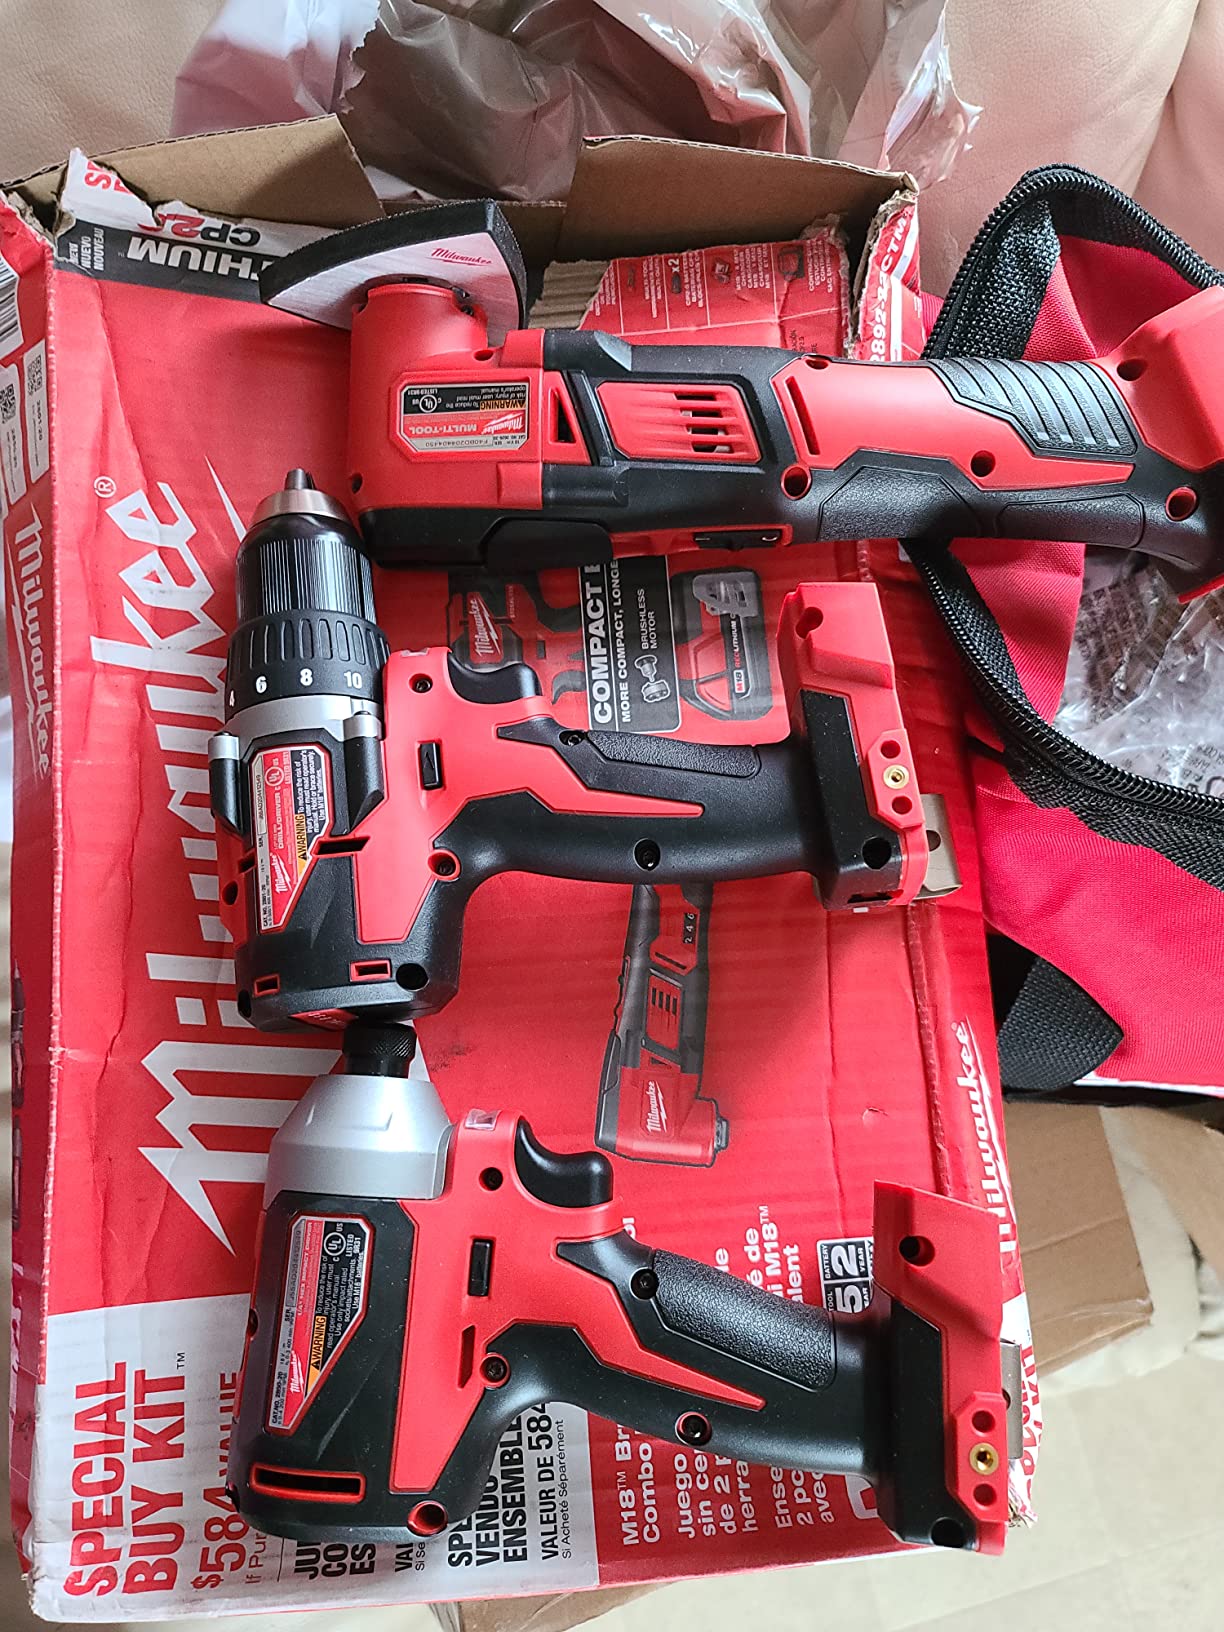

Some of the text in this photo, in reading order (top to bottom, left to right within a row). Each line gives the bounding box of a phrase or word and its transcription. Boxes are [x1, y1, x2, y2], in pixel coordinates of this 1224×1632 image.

[93, 228, 104, 271] NOUVEAU
[431, 248, 492, 264] Milwaukee
[668, 258, 679, 272] x2
[423, 397, 433, 408] UL
[479, 399, 518, 410] WARNING
[408, 423, 476, 434] MULTI-TOOL
[480, 416, 523, 434] Milwaukee
[467, 598, 494, 656] Milwaukee
[637, 588, 649, 649] BRUSHLESS
[647, 610, 657, 648] MOTOR
[15, 513, 50, 773] Milwaukee
[583, 580, 614, 724] COMPACT
[613, 608, 628, 678] COMPACT,
[255, 668, 363, 694] 6 8 10
[734, 670, 744, 692] M18
[619, 681, 631, 722] MORE
[268, 771, 279, 782] UL
[302, 777, 310, 789] read
[309, 775, 317, 789] brace
[303, 789, 311, 803] must
[304, 803, 312, 816] user
[274, 792, 284, 848] DRILL/DRIVER
[295, 814, 306, 853] WARNING
[305, 816, 313, 833] injury,
[270, 852, 288, 892] Milwaukee
[685, 924, 694, 932] 4
[686, 912, 694, 920] 6
[645, 1080, 661, 1132] Milwaukee
[336, 1222, 343, 1231] US
[759, 1205, 781, 1262] M18™
[327, 1237, 341, 1251] UL
[345, 1233, 354, 1256] LISTED
[743, 1227, 760, 1262] de
[821, 1244, 830, 1278] BATTERY
[829, 1243, 858, 1278] 2
[857, 1247, 865, 1272] YEAR
[322, 1295, 330, 1314] injury,
[326, 1262, 334, 1279] must
[340, 1267, 348, 1284] rated
[317, 1284, 325, 1306] reduce
[338, 1284, 346, 1306] impact
[826, 1291, 834, 1311] TOOL
[834, 1283, 863, 1314] 5
[316, 1306, 322, 1314] To
[311, 1316, 325, 1360] WARNING
[326, 1332, 334, 1348] read
[334, 1322, 342, 1336] Use
[289, 1349, 299, 1394] Milwaukee
[63, 1362, 127, 1596] SPECIAL
[537, 1455, 555, 1483] DE
[614, 1422, 639, 1545] M18™ Br
[555, 1418, 572, 1560] Si Acheté Séparément
[637, 1443, 661, 1543] Combo
[673, 1453, 695, 1538] Juego
[698, 1501, 716, 1537] sin
[714, 1474, 736, 1535] de 2
[795, 1509, 814, 1527] 2
[122, 1484, 186, 1594] BUY
[537, 1488, 559, 1561] VALEUR
[321, 1543, 349, 1580] CO
[350, 1544, 377, 1577] ES
[416, 1559, 426, 1571] Si
[245, 1572, 262, 1584] If
